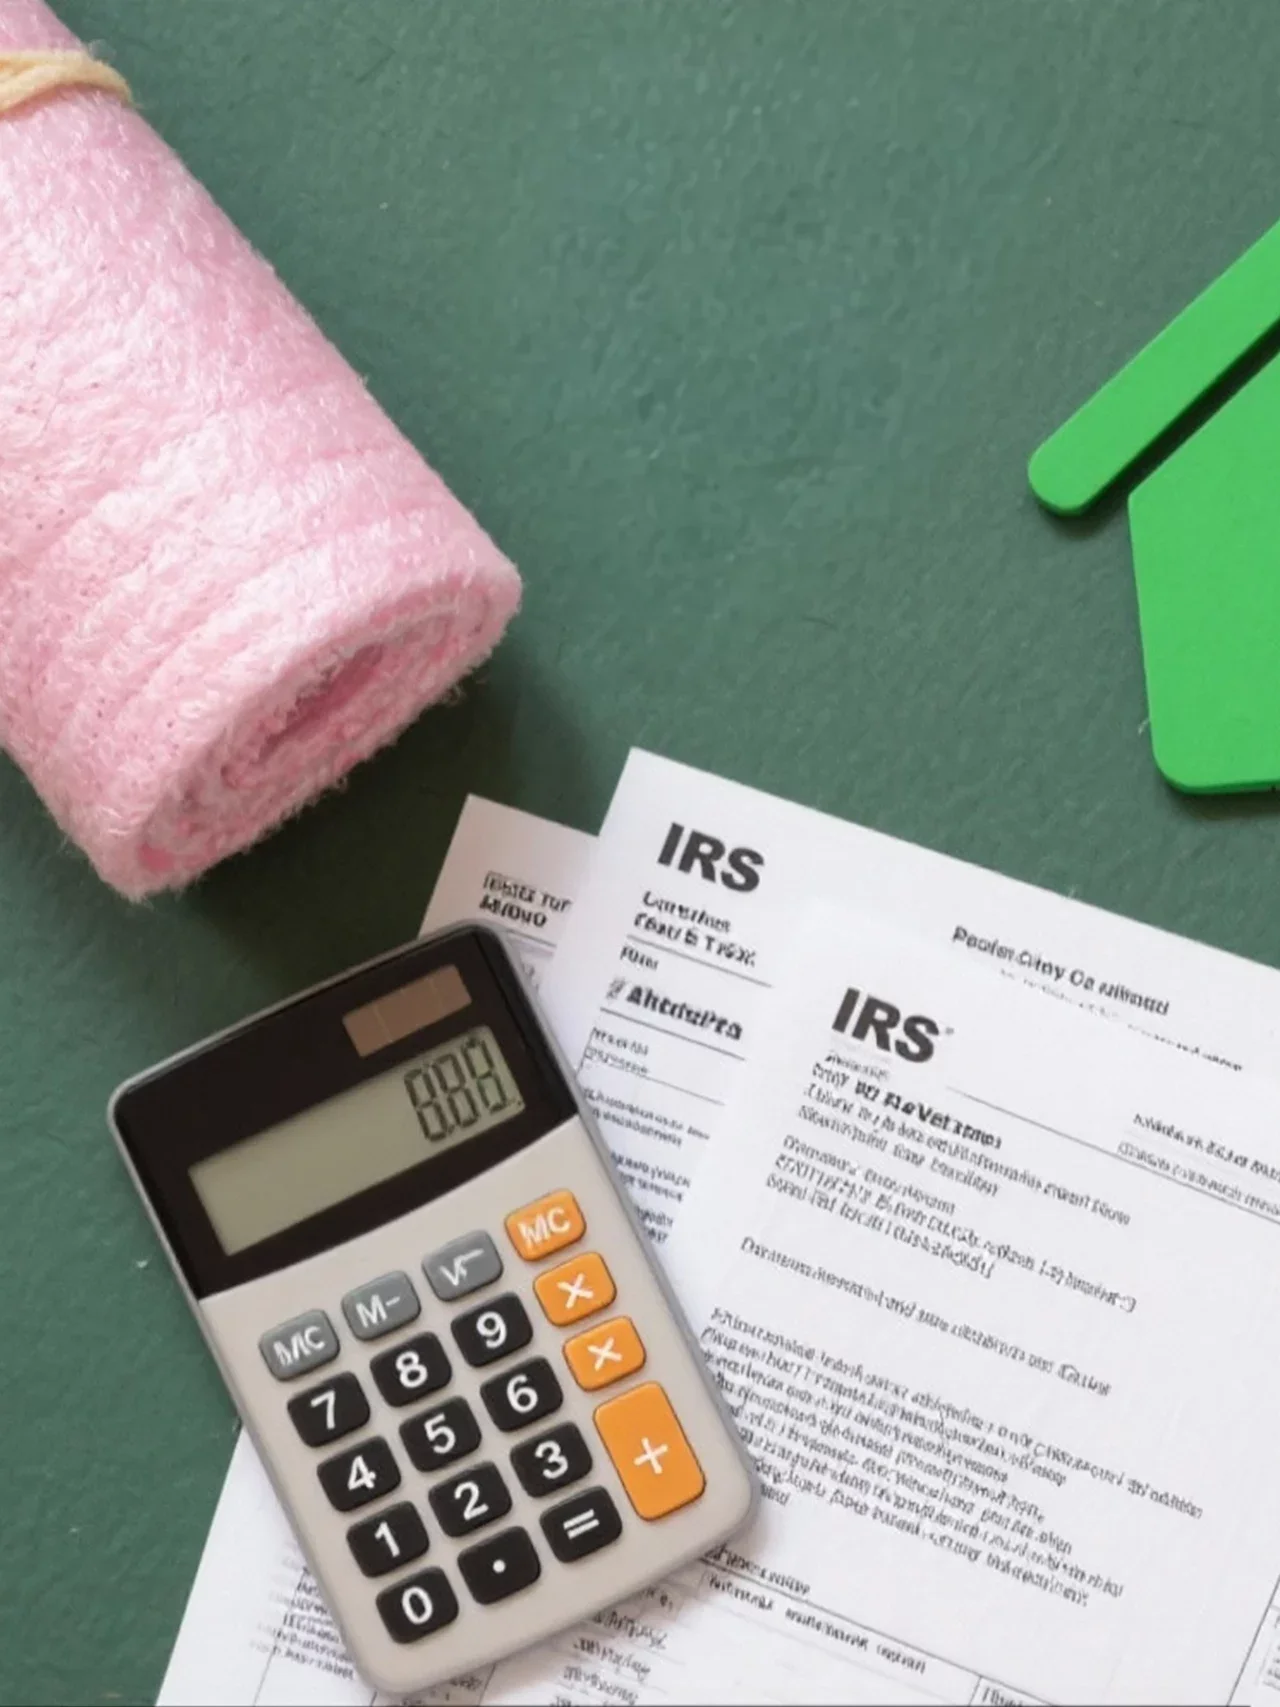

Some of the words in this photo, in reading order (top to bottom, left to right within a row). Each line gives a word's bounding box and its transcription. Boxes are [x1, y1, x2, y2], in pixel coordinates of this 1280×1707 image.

[658, 822, 765, 893] IRS
[831, 987, 940, 1064] IRS
[517, 1207, 571, 1249] MC
[272, 1325, 326, 1366] MC
[476, 1311, 507, 1349] 9
[395, 1351, 428, 1388] 8
[310, 1390, 336, 1429] 7
[506, 1374, 538, 1413] 6
[424, 1414, 455, 1454] 5
[347, 1455, 376, 1490] 4
[535, 1440, 569, 1479] 3
[454, 1481, 489, 1521] 2
[374, 1521, 400, 1558] 1
[401, 1586, 433, 1624] 0
